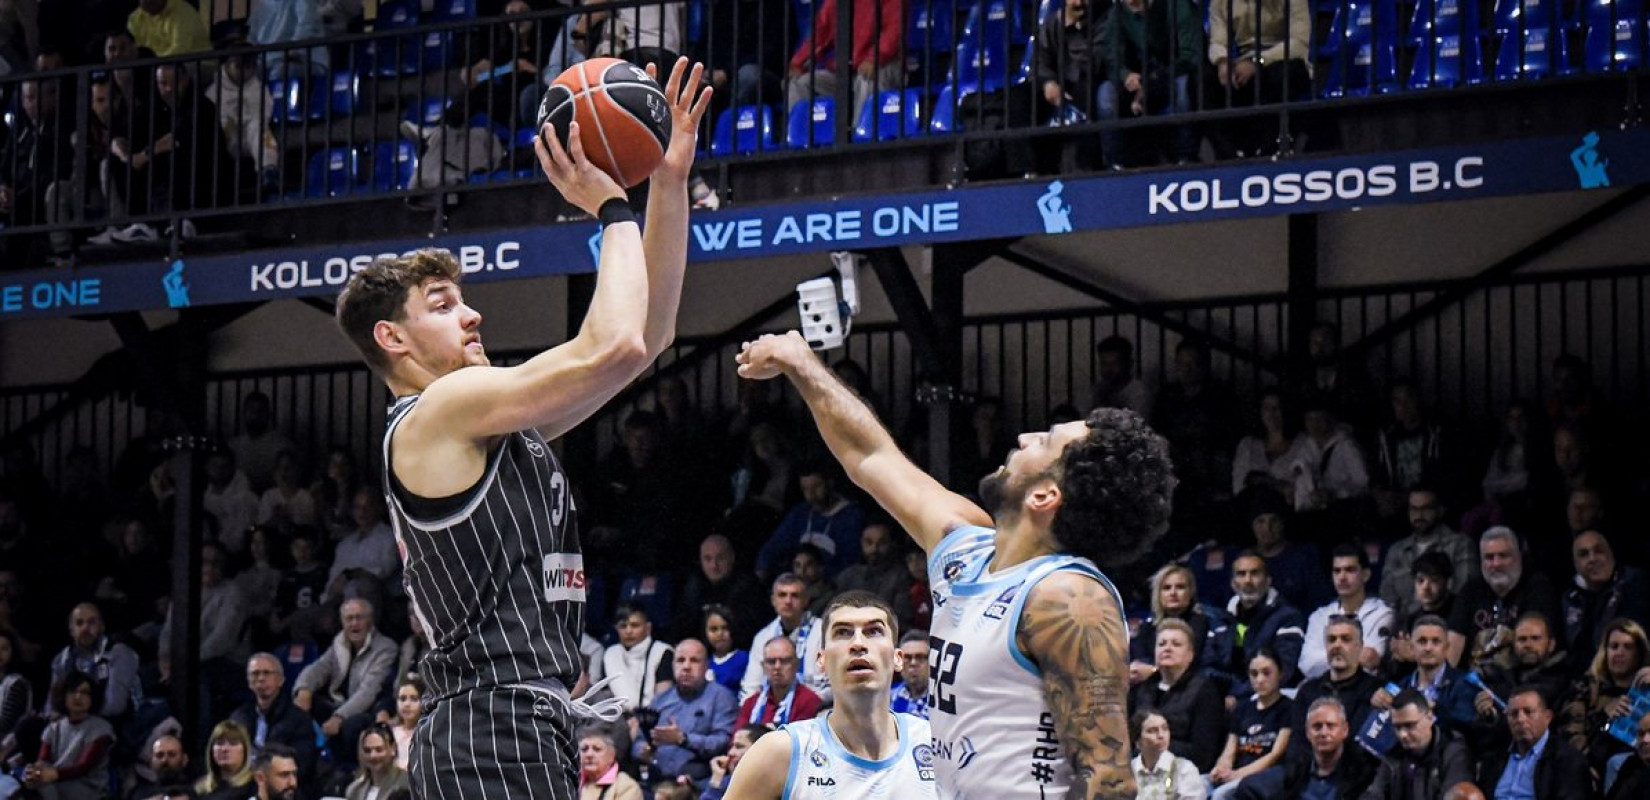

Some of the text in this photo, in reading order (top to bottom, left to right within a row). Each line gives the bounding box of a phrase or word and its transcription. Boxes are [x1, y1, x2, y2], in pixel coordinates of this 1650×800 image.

[1148, 157, 1483, 215] KOLOSSOS B.C
[692, 200, 960, 252] WE ARE ONE
[460, 241, 520, 274] B.C
[32, 279, 100, 309] ONE
[807, 775, 837, 787] FILA
